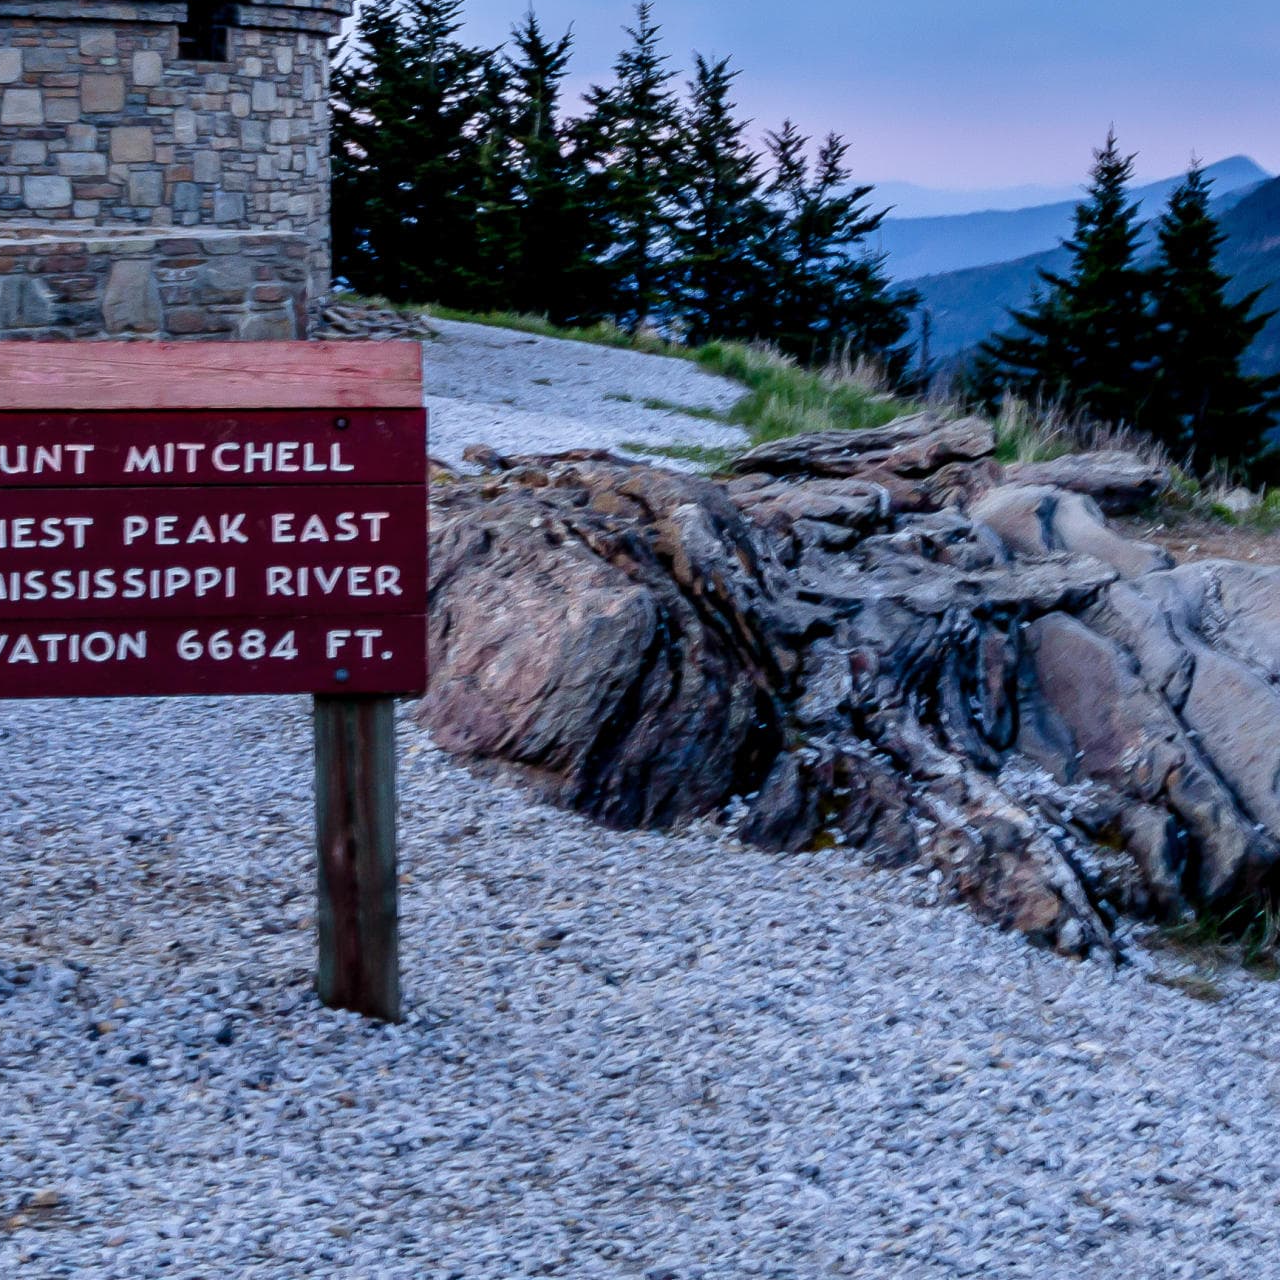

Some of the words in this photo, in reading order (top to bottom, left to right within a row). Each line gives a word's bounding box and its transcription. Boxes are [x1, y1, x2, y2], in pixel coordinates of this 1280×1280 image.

[123, 441, 355, 474] MITCHELL
[123, 513, 249, 546] PEAK
[271, 511, 390, 543] EAST
[266, 565, 403, 597] RIVER
[176, 628, 299, 661] 6684
[326, 628, 393, 660] FT.
